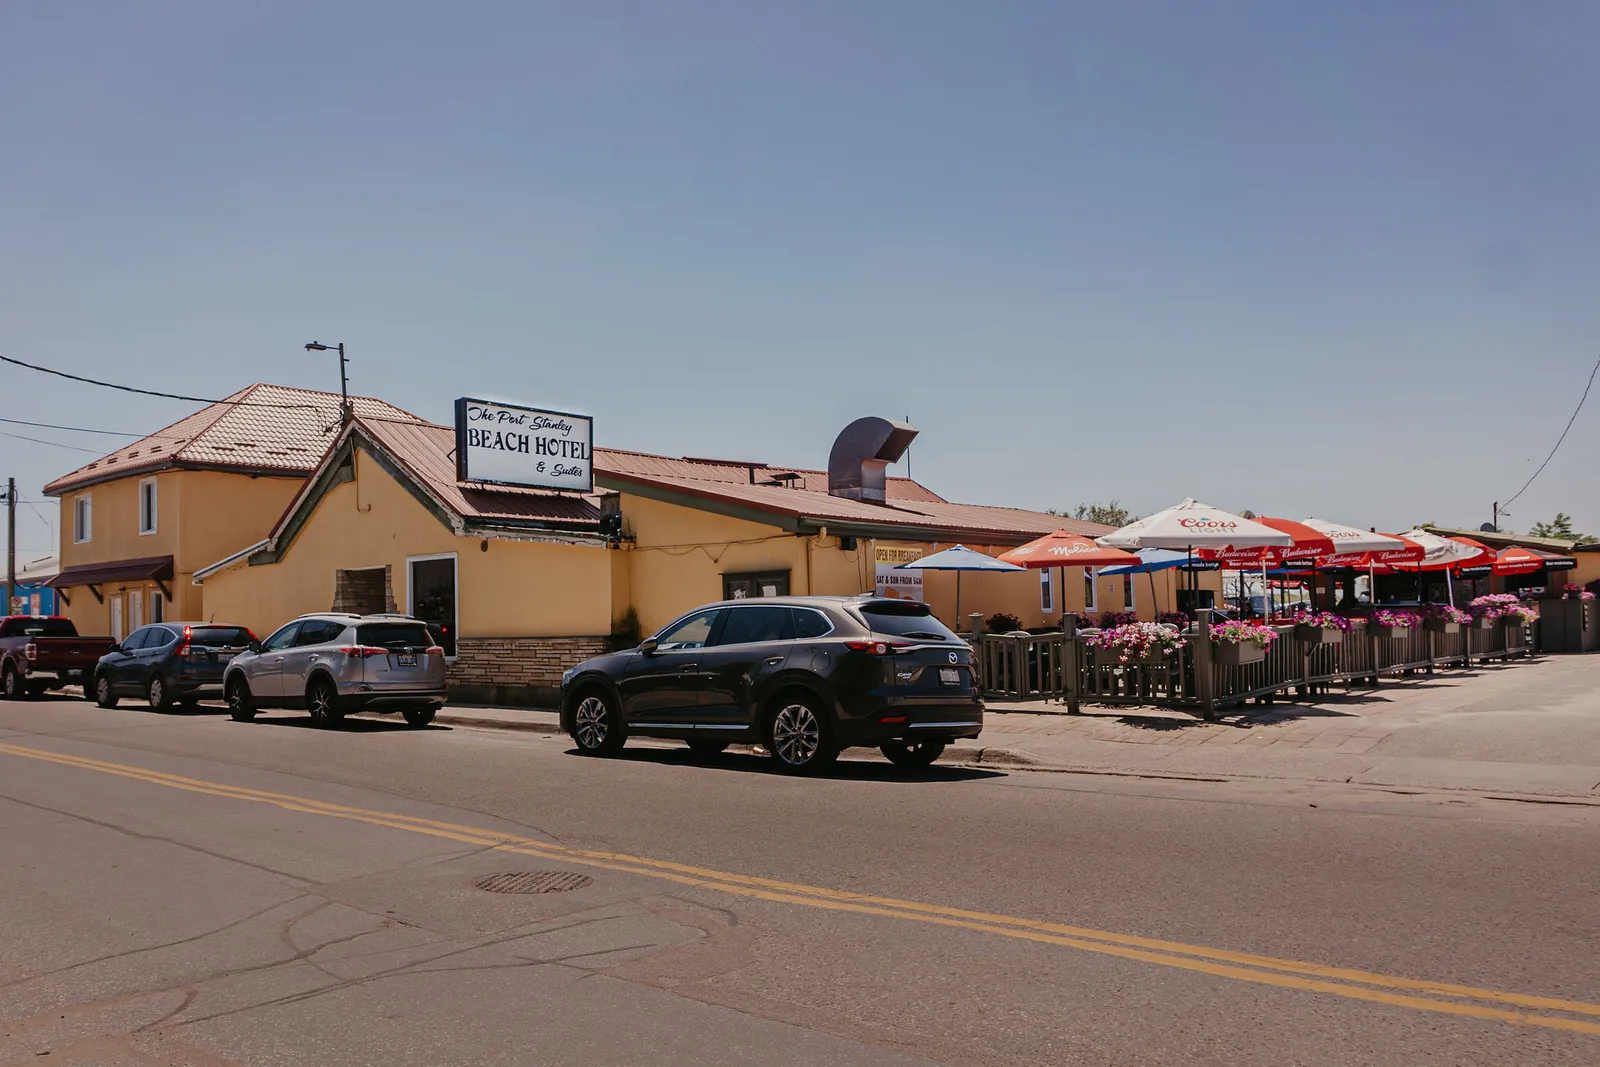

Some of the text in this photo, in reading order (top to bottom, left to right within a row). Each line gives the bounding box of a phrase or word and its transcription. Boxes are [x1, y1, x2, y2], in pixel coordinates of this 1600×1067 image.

[468, 406, 573, 436] The Port Stanley
[468, 428, 590, 460] BEACH HOTEL
[536, 461, 583, 477] & Suites
[1177, 517, 1238, 528] Coors
[876, 548, 889, 561] OPEN
[889, 549, 898, 561] FOR
[1048, 542, 1101, 556] Molson
[1214, 548, 1259, 559] Budweiser
[1279, 547, 1323, 558] Budweiser
[1379, 551, 1417, 560] Budweiser
[876, 575, 884, 584] SAT
[890, 576, 899, 584] SUN
[900, 577, 913, 585] FROM
